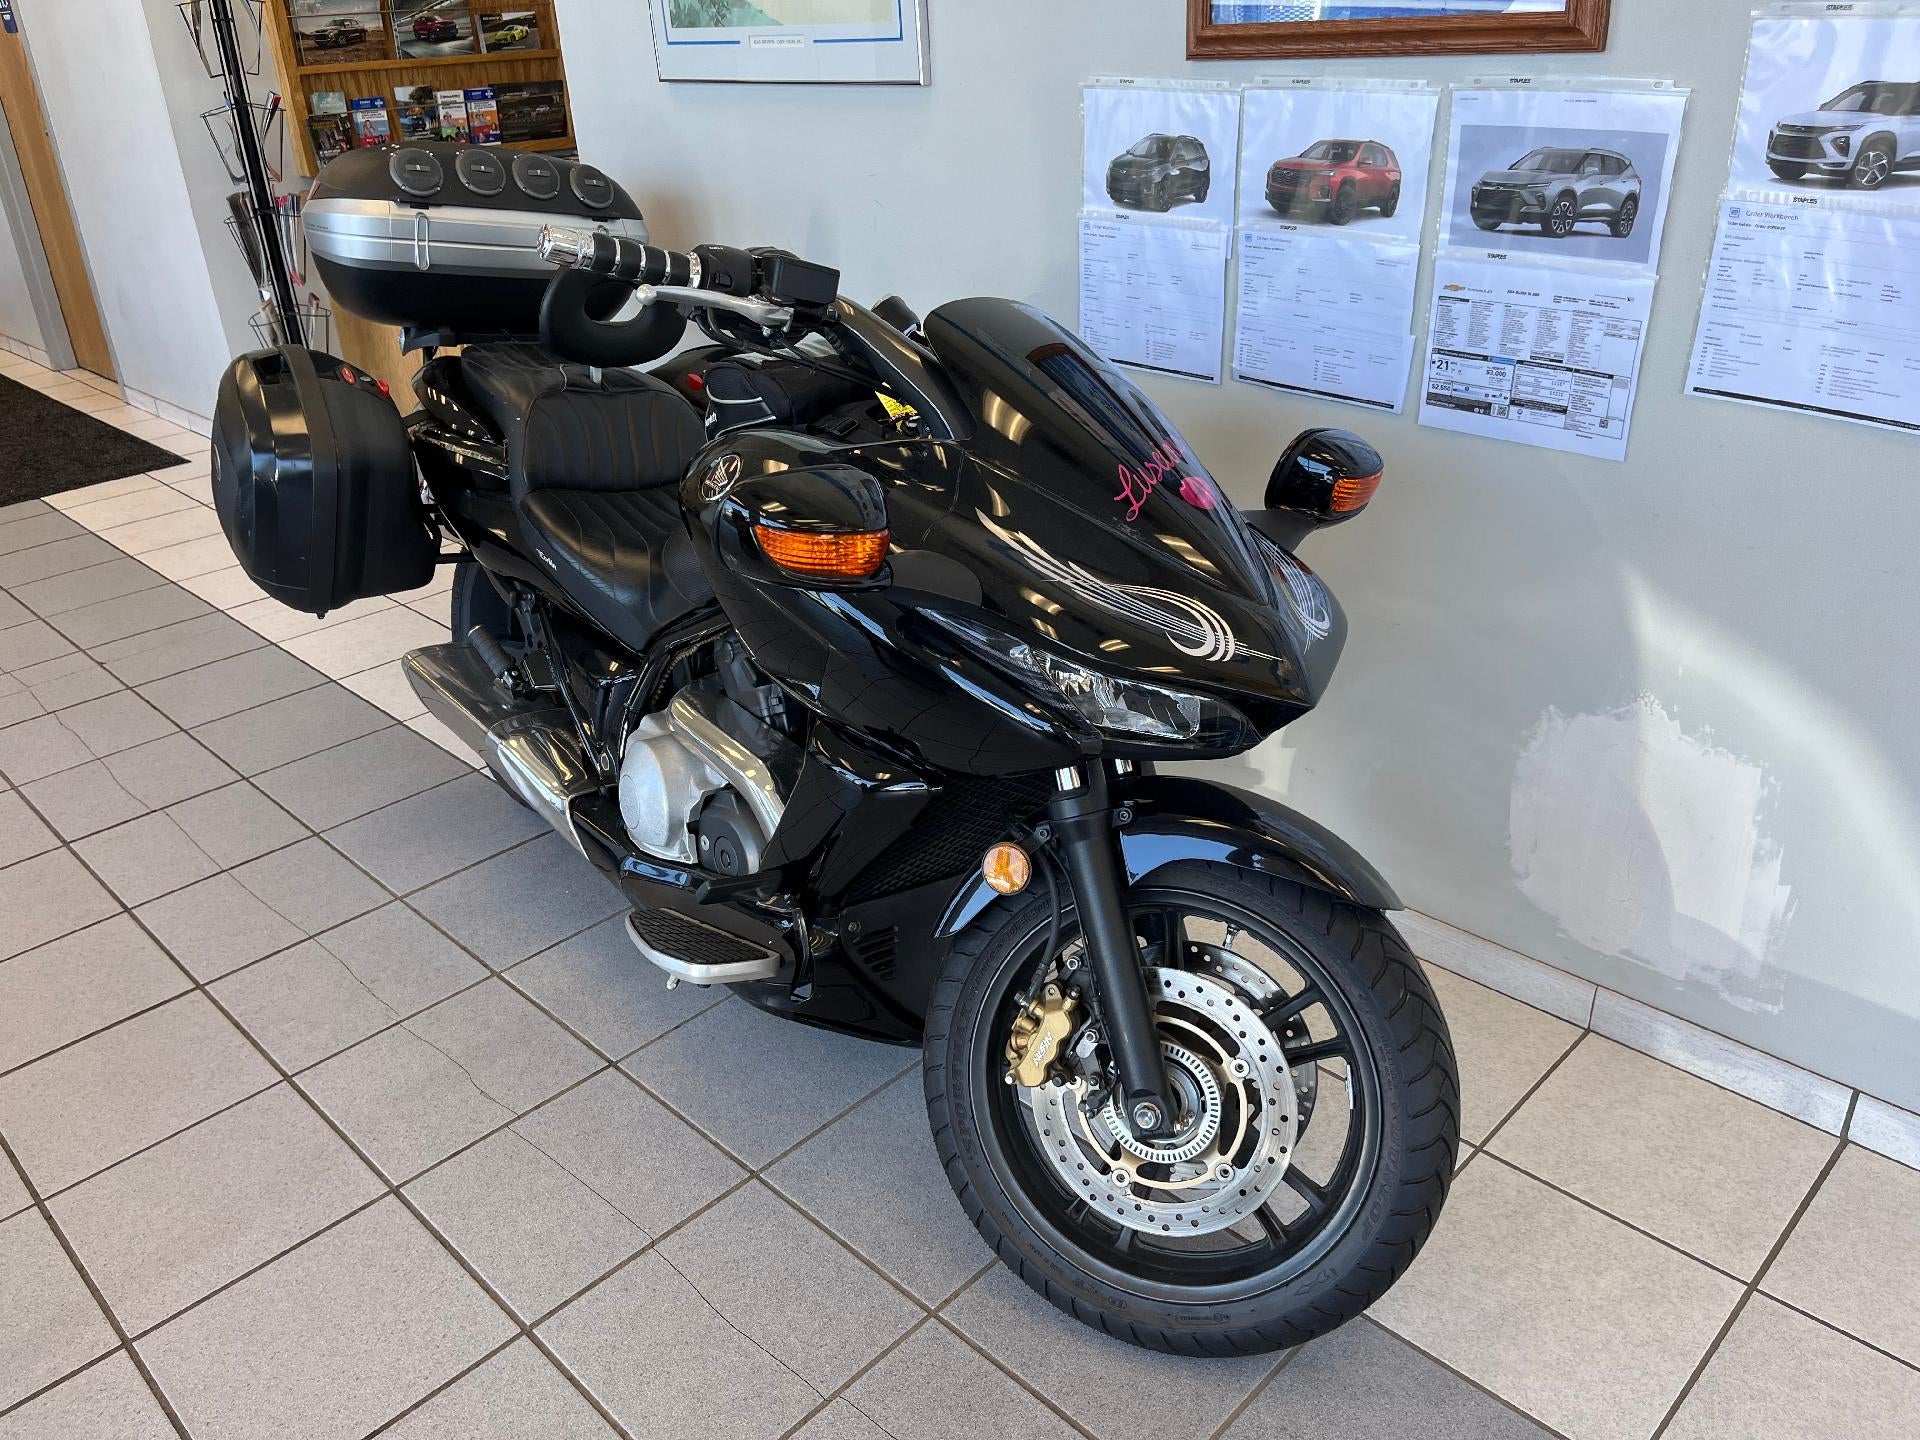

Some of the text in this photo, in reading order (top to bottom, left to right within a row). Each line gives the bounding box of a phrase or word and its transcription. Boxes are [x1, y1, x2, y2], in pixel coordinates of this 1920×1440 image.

[1792, 196, 1818, 204] STAPLES
[1436, 359, 1449, 371] 21
[1486, 369, 1507, 378] $3,000
